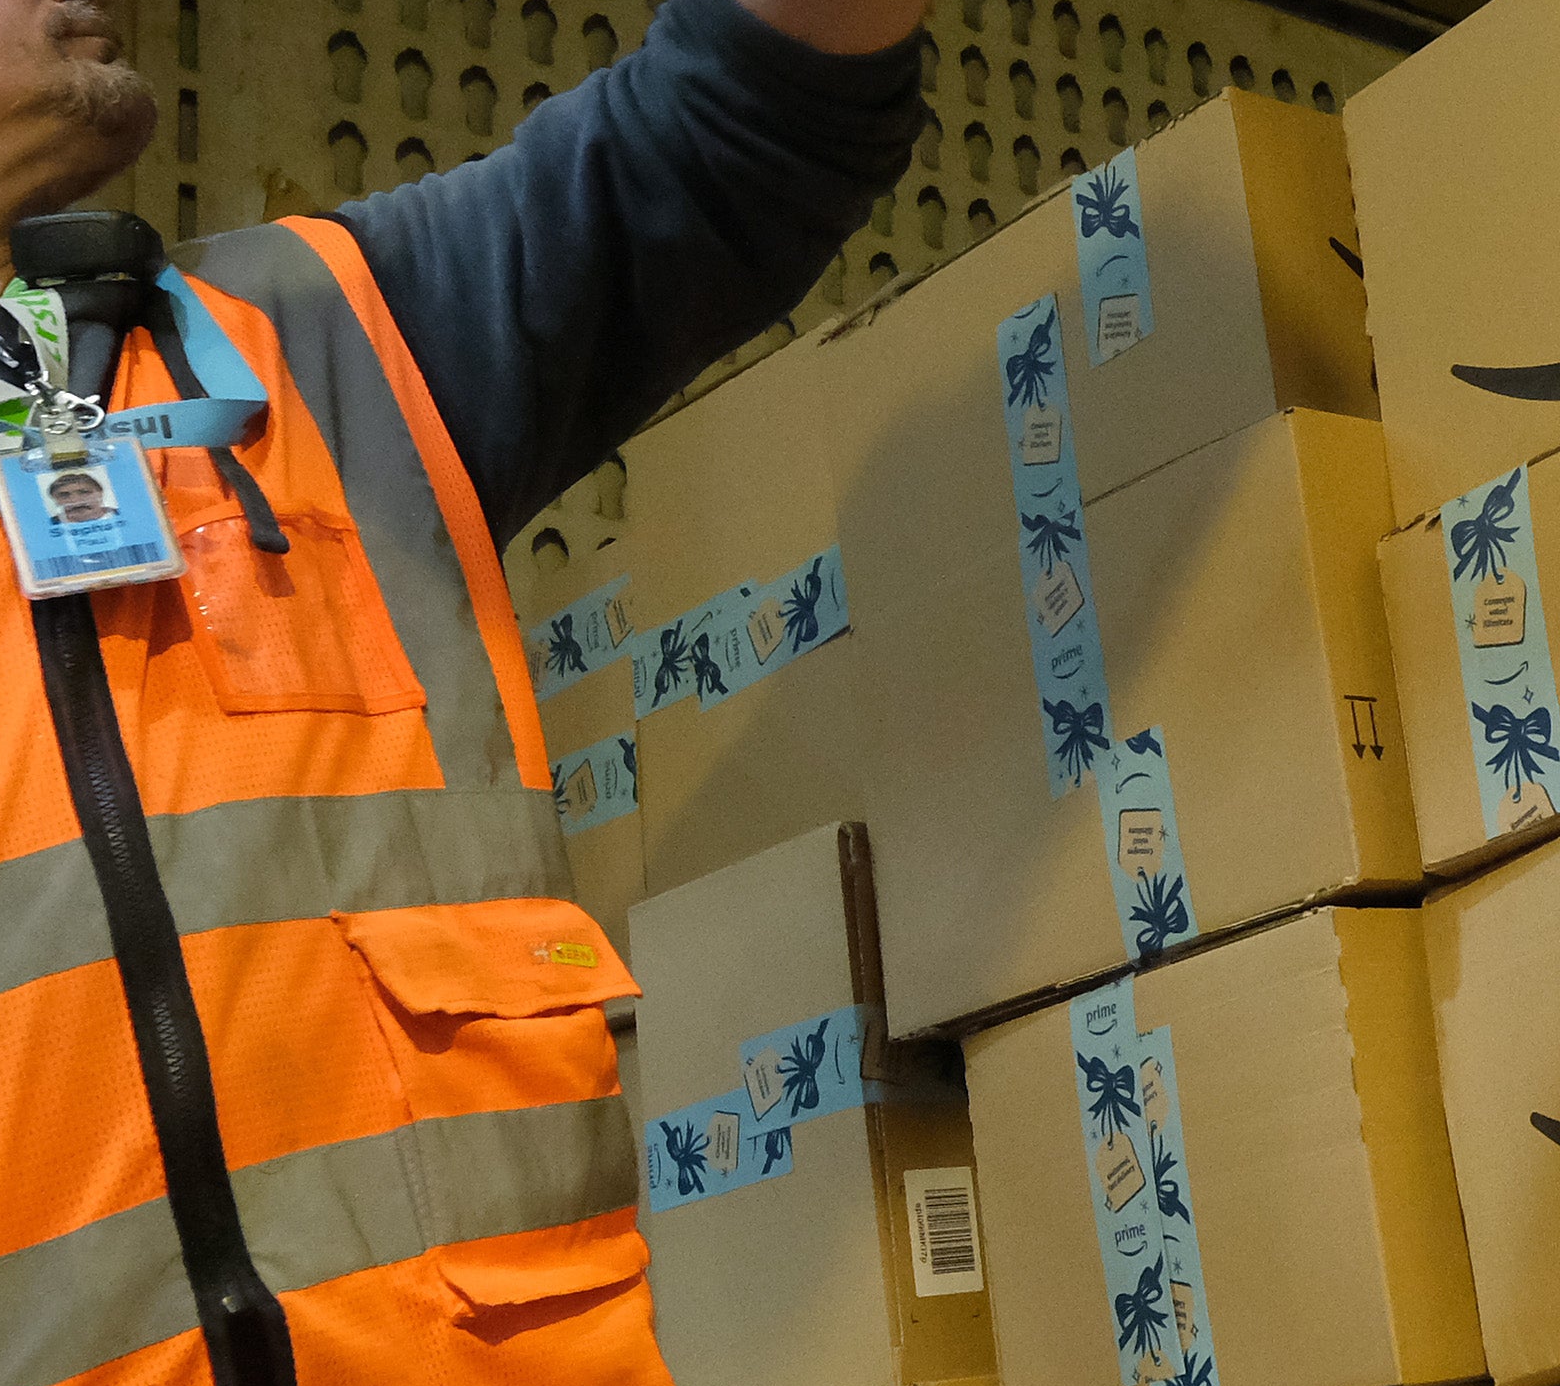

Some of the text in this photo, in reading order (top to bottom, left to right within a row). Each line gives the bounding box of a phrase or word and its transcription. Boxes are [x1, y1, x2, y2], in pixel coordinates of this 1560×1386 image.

[729, 627, 742, 668] prime
[1050, 644, 1084, 673] prime
[1086, 1003, 1117, 1029] prime
[1114, 1223, 1147, 1249] prime
